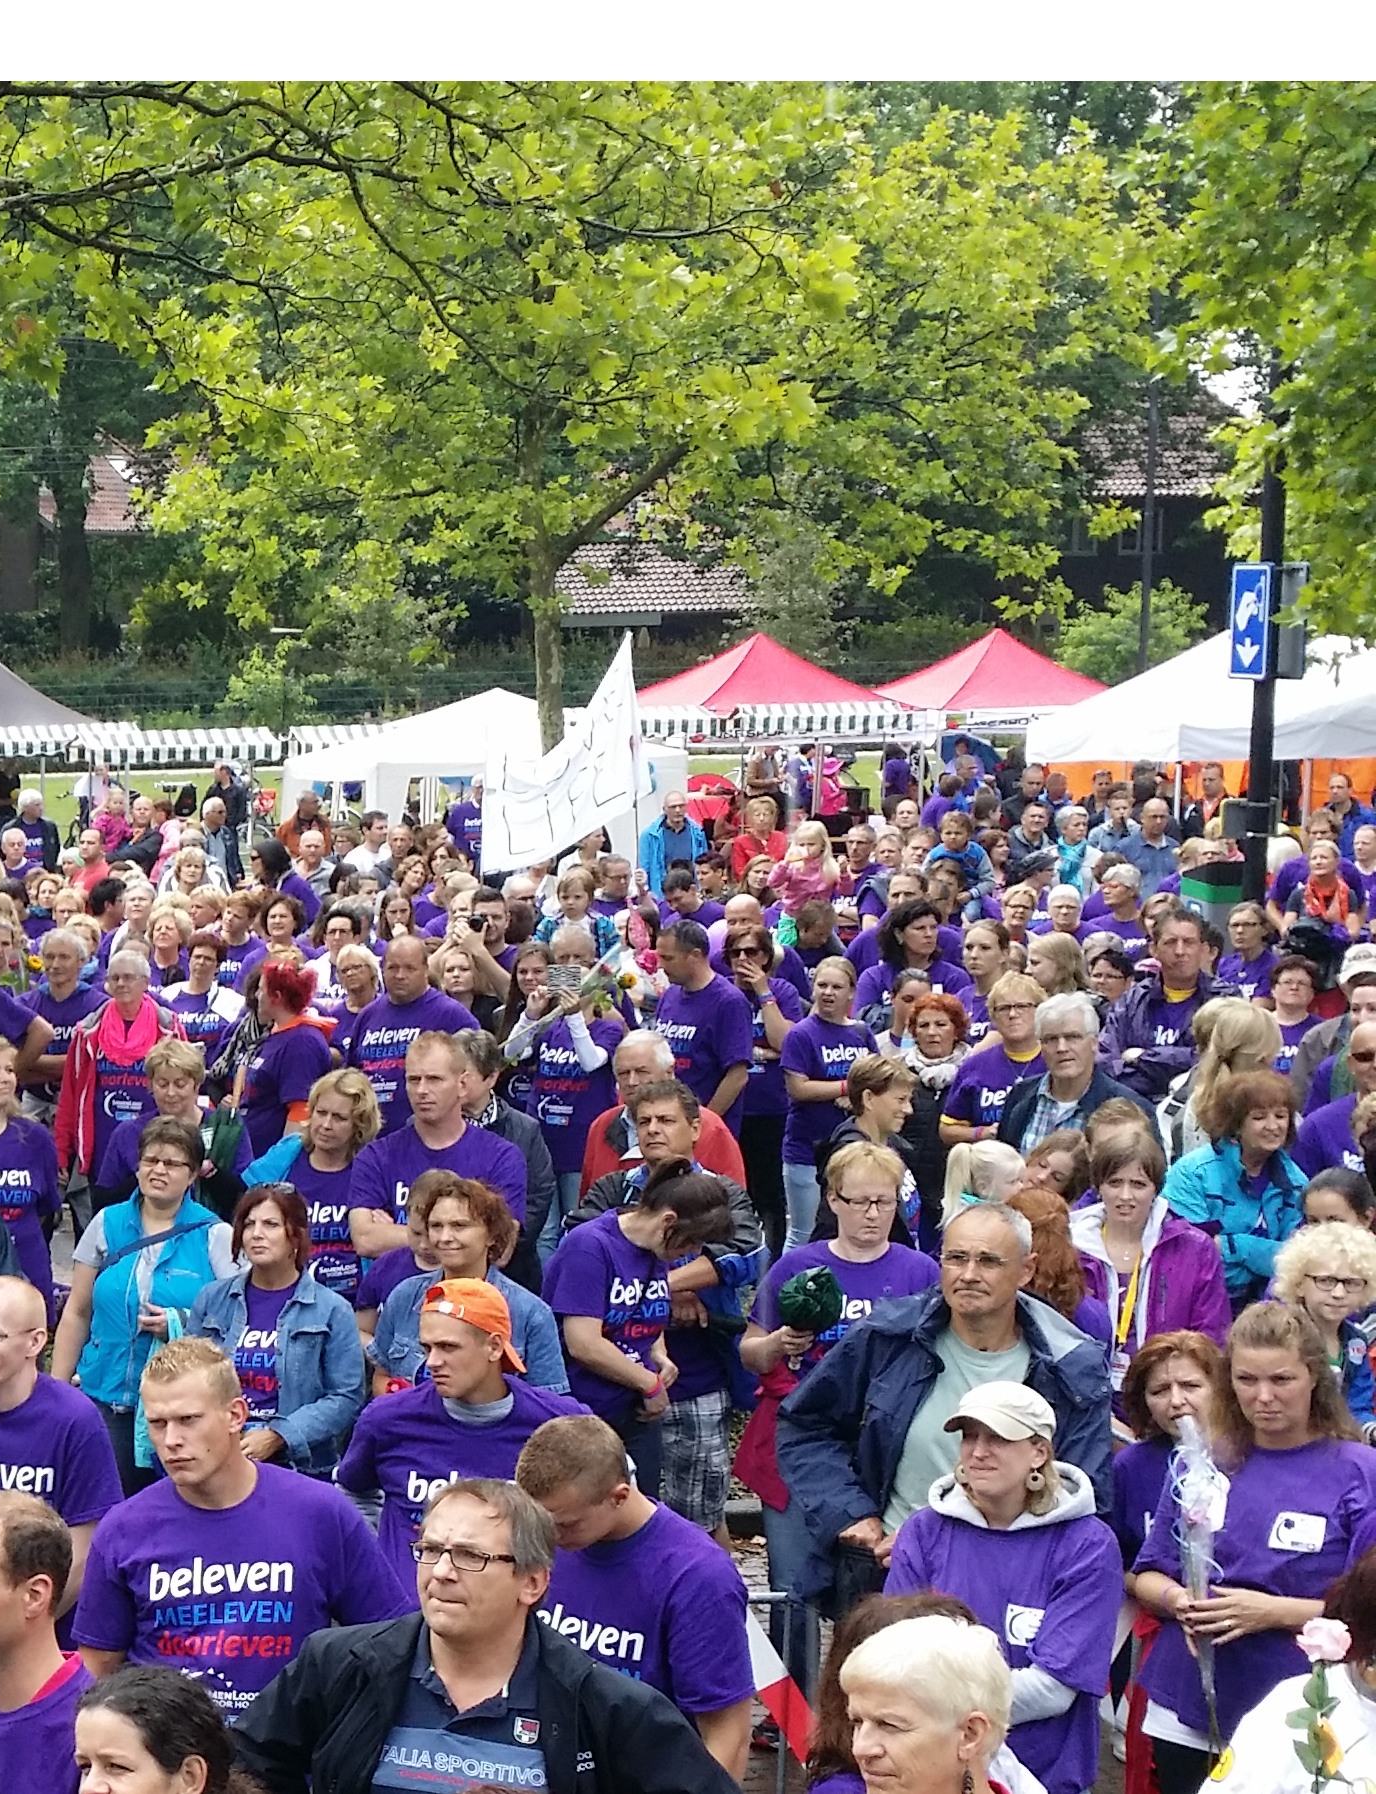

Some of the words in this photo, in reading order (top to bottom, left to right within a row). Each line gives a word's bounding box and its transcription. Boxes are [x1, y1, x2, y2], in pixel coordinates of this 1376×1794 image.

[150, 1557, 292, 1600] beleven
[153, 1601, 293, 1627] MEELEVEN
[157, 1627, 291, 1657] doorleven
[434, 1753, 547, 1786] SPORTIVO
